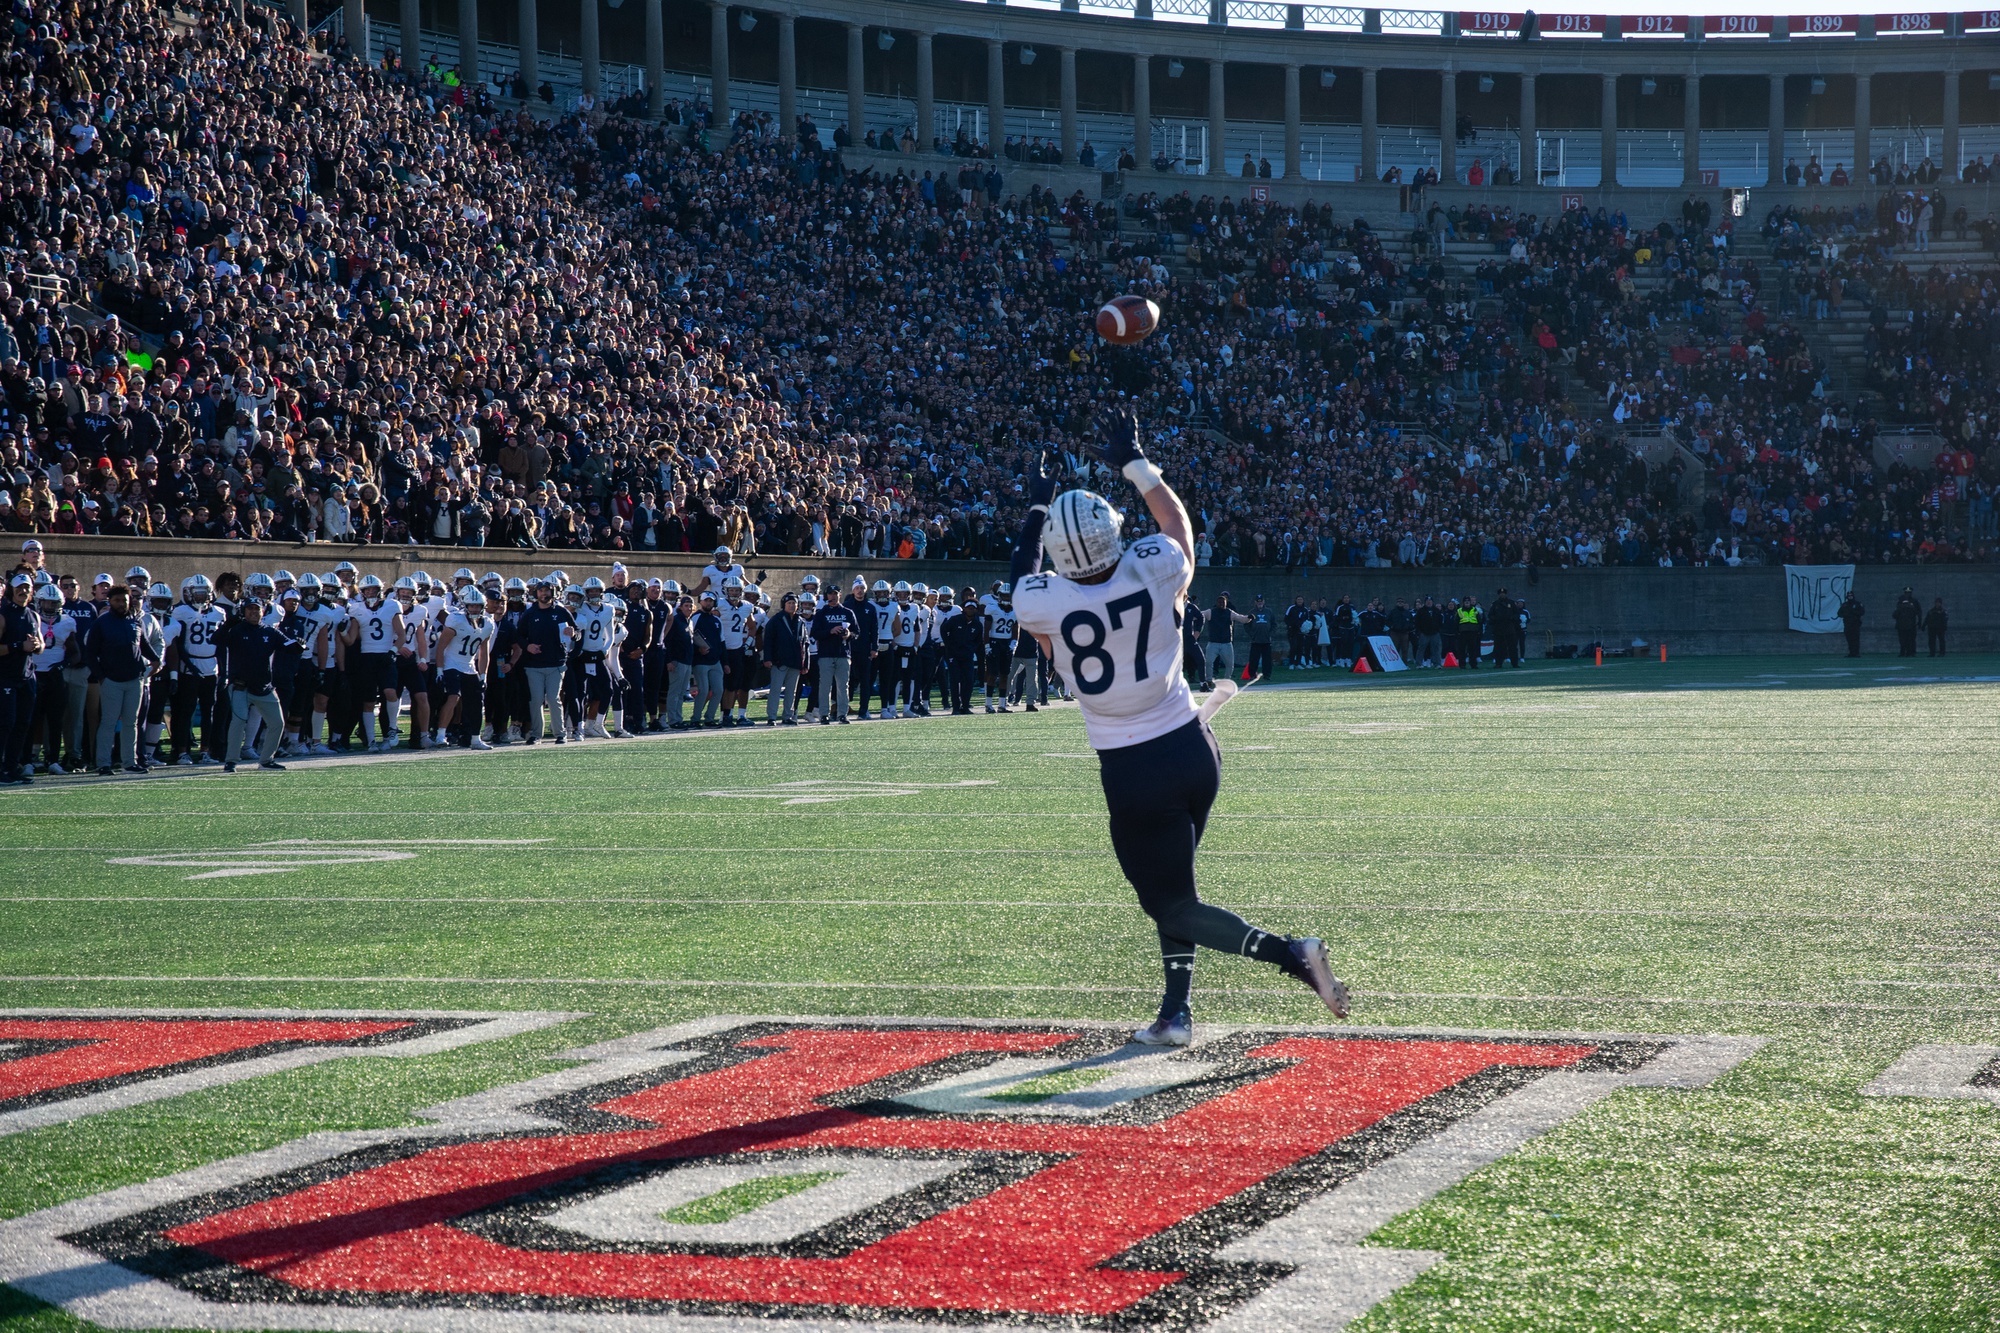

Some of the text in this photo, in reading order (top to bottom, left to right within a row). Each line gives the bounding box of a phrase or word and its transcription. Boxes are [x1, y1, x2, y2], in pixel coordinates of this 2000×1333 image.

[1474, 13, 1510, 29] 1919
[1555, 15, 1591, 31] 1913
[1636, 16, 1673, 32] 1912
[1720, 16, 1757, 32] 1910
[1804, 16, 1842, 32] 1899
[1892, 14, 1930, 30] 1898
[1702, 172, 1714, 185] 17
[1255, 188, 1267, 202] 15
[1566, 197, 1579, 210] 16
[84, 418, 107, 427] YALE
[440, 507, 449, 516] Y
[1134, 541, 1161, 559] 87
[1070, 563, 1107, 579] Riddell
[1025, 573, 1048, 591] 87
[1791, 573, 1851, 622] DIVEST
[62, 609, 91, 618] YALE
[879, 612, 889, 630] 7
[369, 617, 384, 641] 3
[589, 619, 601, 641] 9
[731, 613, 741, 633] 2
[901, 617, 911, 635] 6
[996, 617, 1013, 634] 29
[190, 621, 216, 645] 85
[404, 622, 416, 645] 0
[458, 635, 482, 657] 10
[1060, 588, 1153, 695] 87
